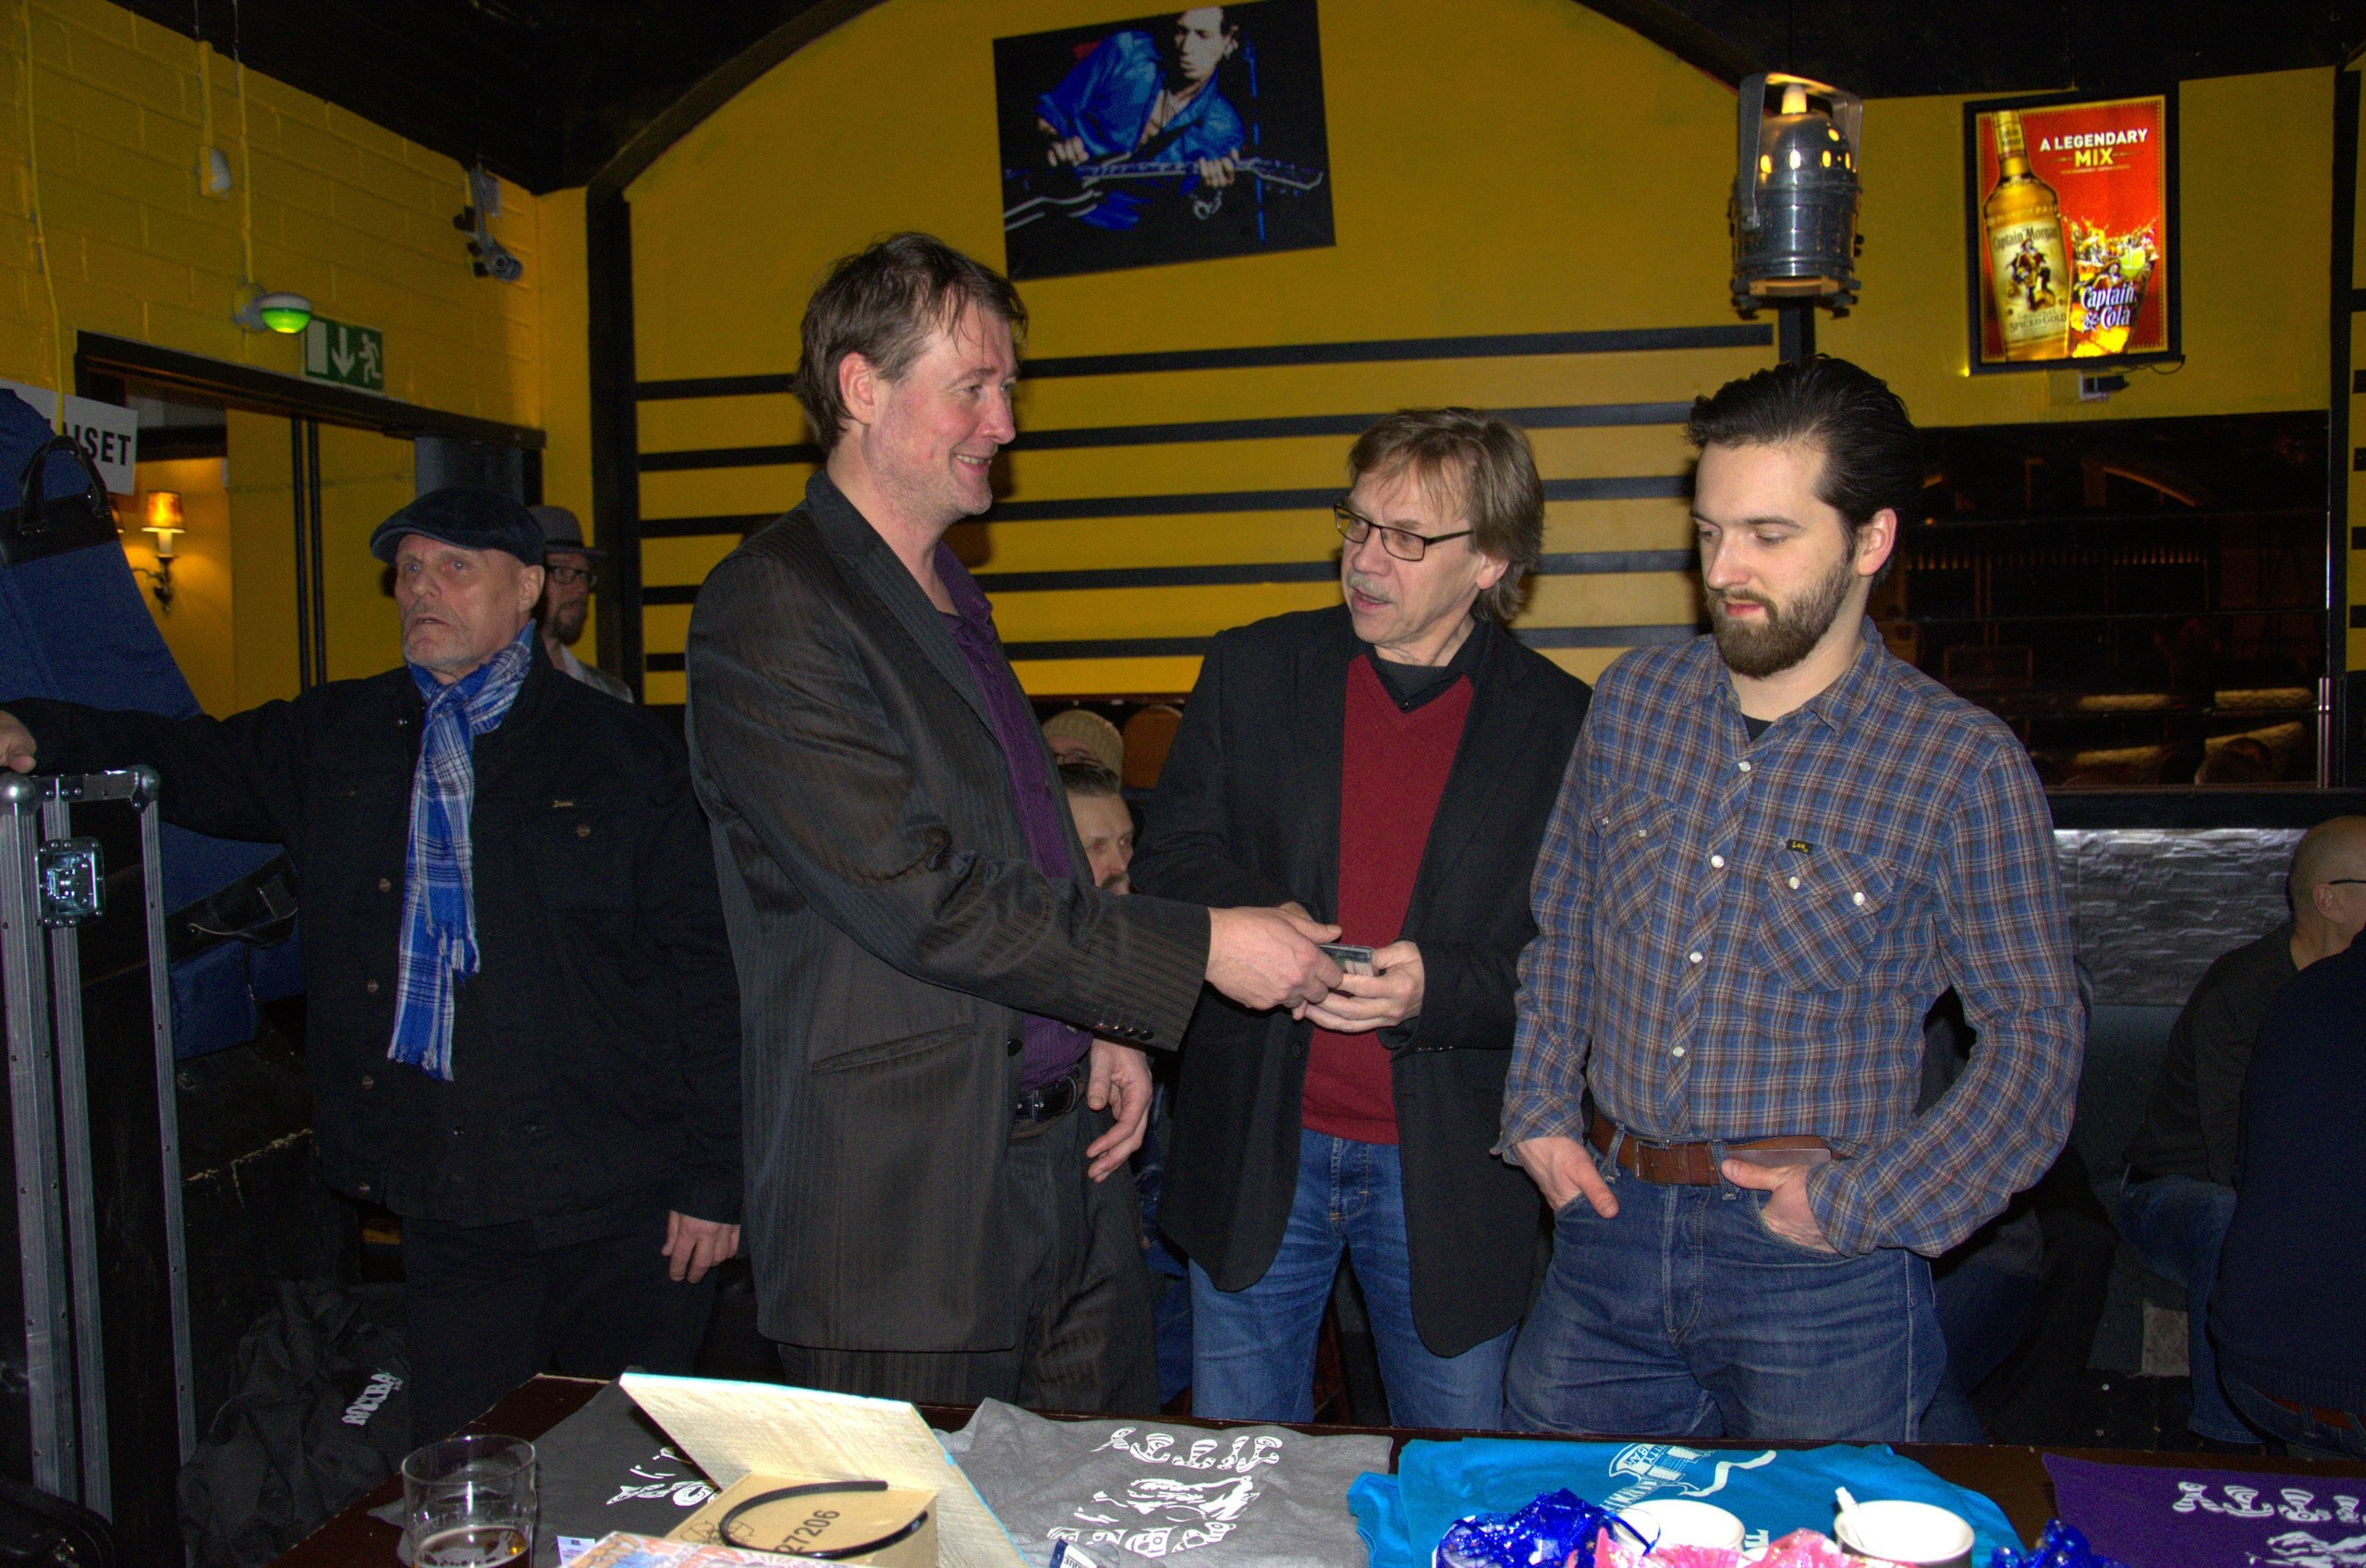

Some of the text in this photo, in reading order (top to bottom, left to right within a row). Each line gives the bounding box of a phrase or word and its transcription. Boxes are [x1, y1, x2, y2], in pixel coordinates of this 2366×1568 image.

[2039, 128, 2148, 152] A LEGENDARY
[2074, 148, 2115, 167] MIX
[2079, 281, 2137, 311] Captain
[2101, 305, 2131, 330] Cola
[46, 419, 131, 466] ISET
[2172, 1480, 2366, 1524] ITTY
